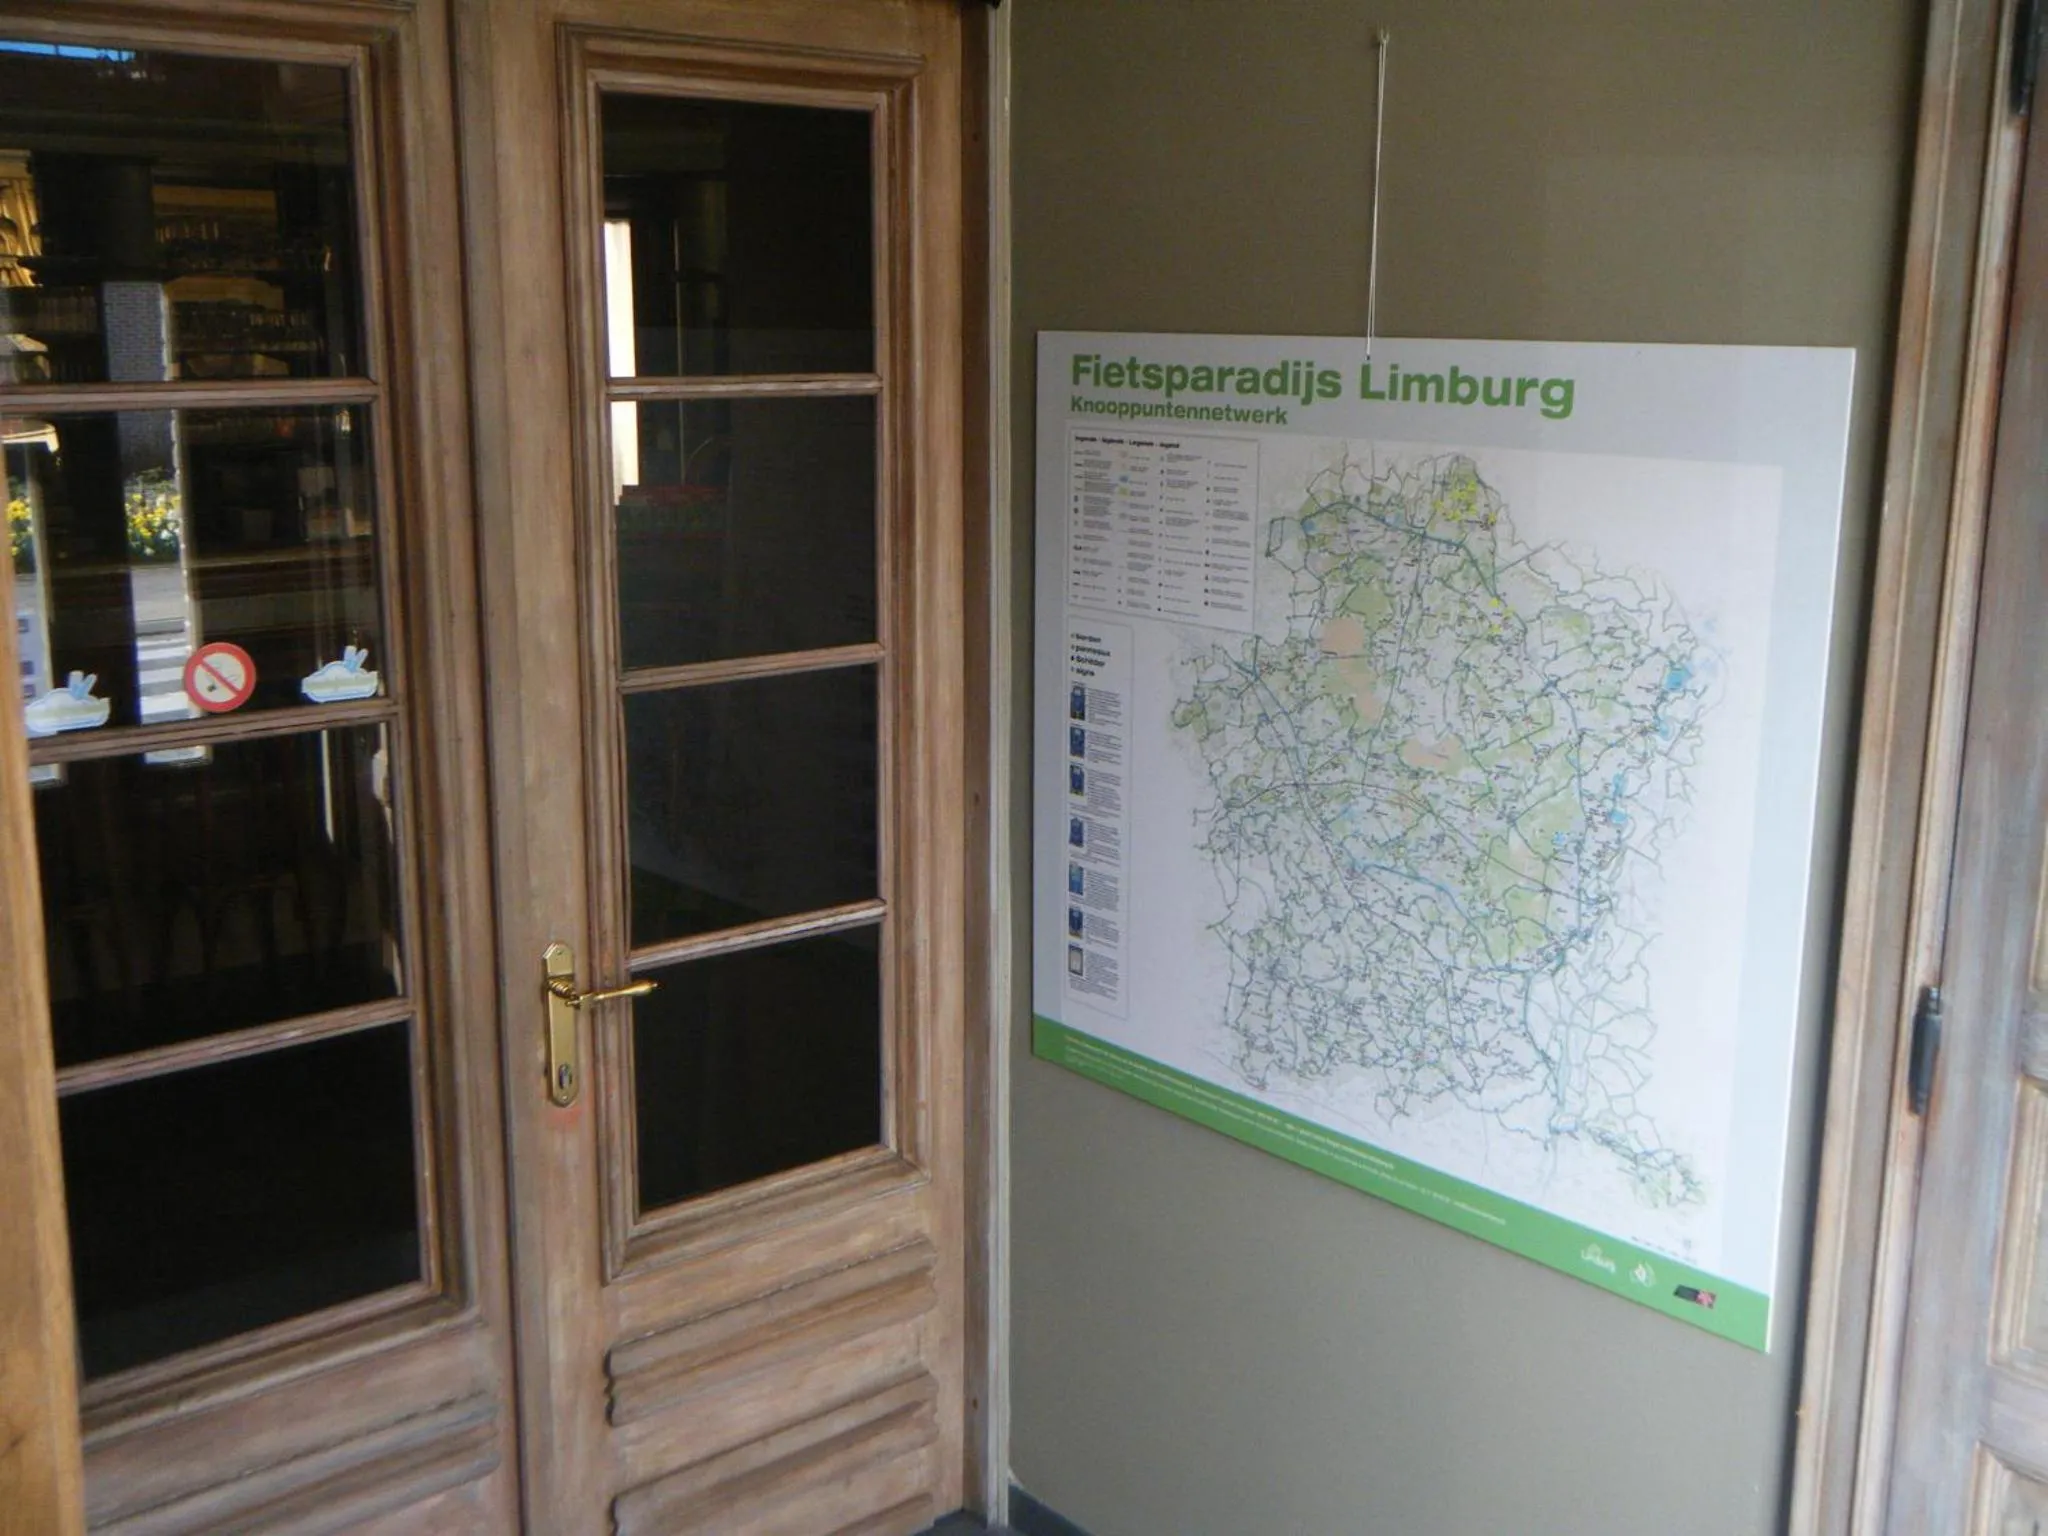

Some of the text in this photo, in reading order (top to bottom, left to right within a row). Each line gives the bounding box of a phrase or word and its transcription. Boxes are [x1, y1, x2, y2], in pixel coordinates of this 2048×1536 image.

[1071, 395, 1288, 425] Knooppuntennetwerk
[1072, 354, 1575, 420] Fietsparadijs Limburg
